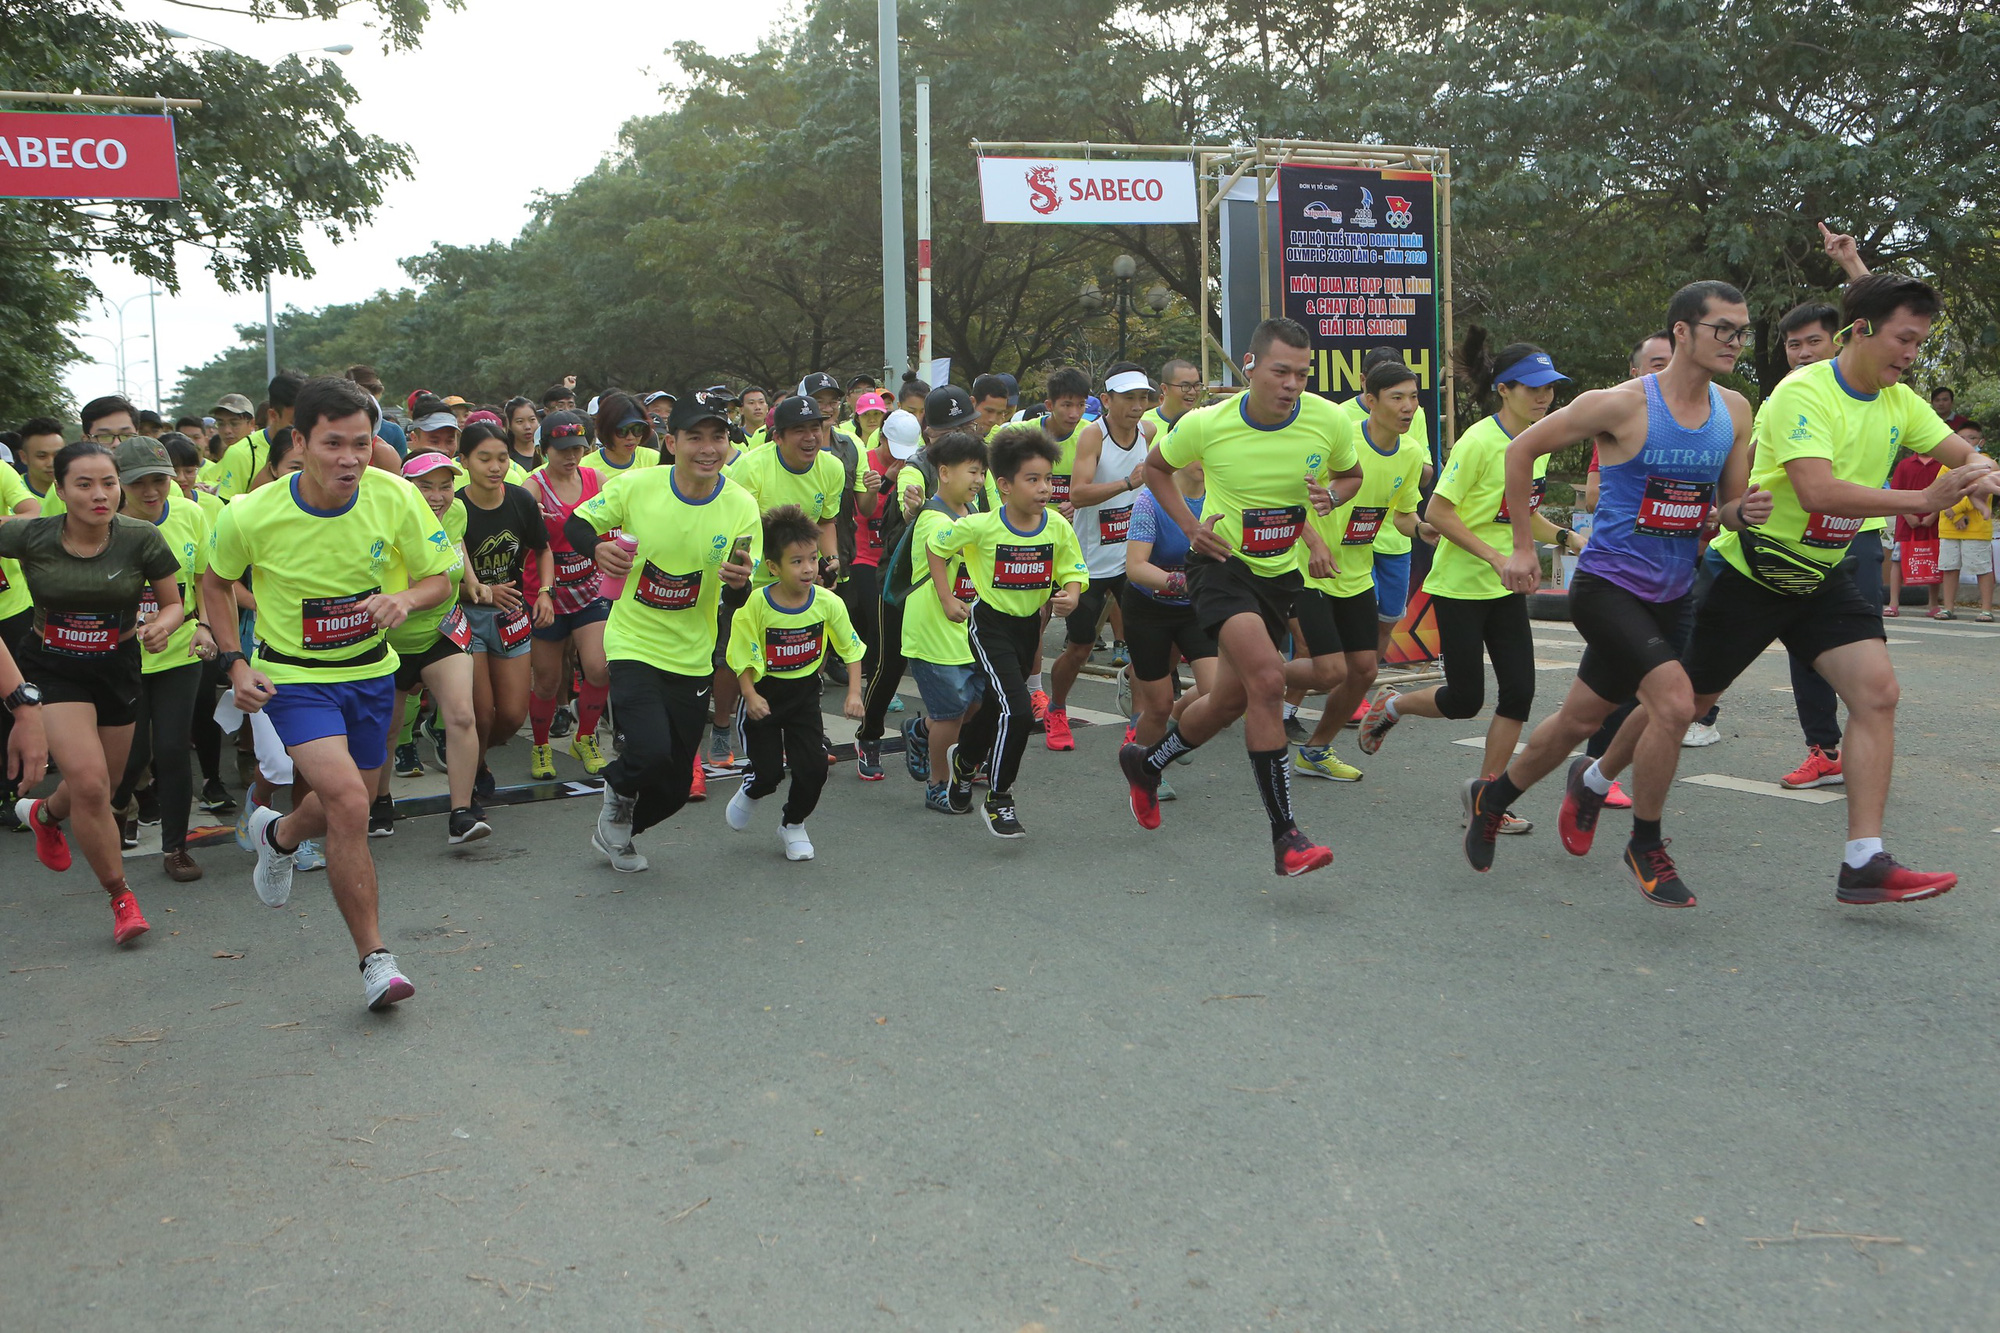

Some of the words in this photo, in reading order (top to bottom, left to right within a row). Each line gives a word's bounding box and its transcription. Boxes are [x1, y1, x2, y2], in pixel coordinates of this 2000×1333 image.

[1069, 178, 1163, 201] SABECO
[1291, 231, 1307, 247] ĐẠI
[1309, 230, 1325, 247] HỘI
[1327, 228, 1344, 246] THỂ
[1345, 232, 1367, 246] THAO
[1369, 233, 1398, 247] DOANH
[1400, 232, 1423, 248] NHÂN
[1287, 247, 1325, 262] OLYMPIC
[1327, 248, 1350, 262] 2030
[1353, 245, 1368, 263] LẦN
[1370, 250, 1377, 263] 6
[1384, 248, 1403, 264] NĂM
[1405, 250, 1427, 264] 2020
[1290, 274, 1317, 293] MÔN
[1320, 277, 1343, 293] ĐUA
[1344, 277, 1358, 294] XE
[1360, 277, 1382, 296] ĐẠP
[1384, 278, 1404, 297] ĐỊA
[1405, 276, 1431, 294] HÌNH
[1306, 300, 1315, 314] &
[1317, 298, 1346, 317] CHẠY
[1350, 296, 1365, 317] BỘ
[1368, 298, 1387, 317] ĐỊA
[1389, 296, 1415, 315] HÌNH
[1320, 315, 1343, 336] GIẢI
[1346, 320, 1366, 336] BIA
[1367, 320, 1407, 336] SAIGON
[1652, 502, 1702, 518] T100089
[1254, 525, 1296, 541] T100187
[561, 558, 592, 574] T100194
[1004, 563, 1045, 574] T100195
[648, 582, 690, 598] T100147
[316, 611, 369, 632] T100132
[57, 628, 108, 643] T100122
[775, 640, 816, 657] T100196
